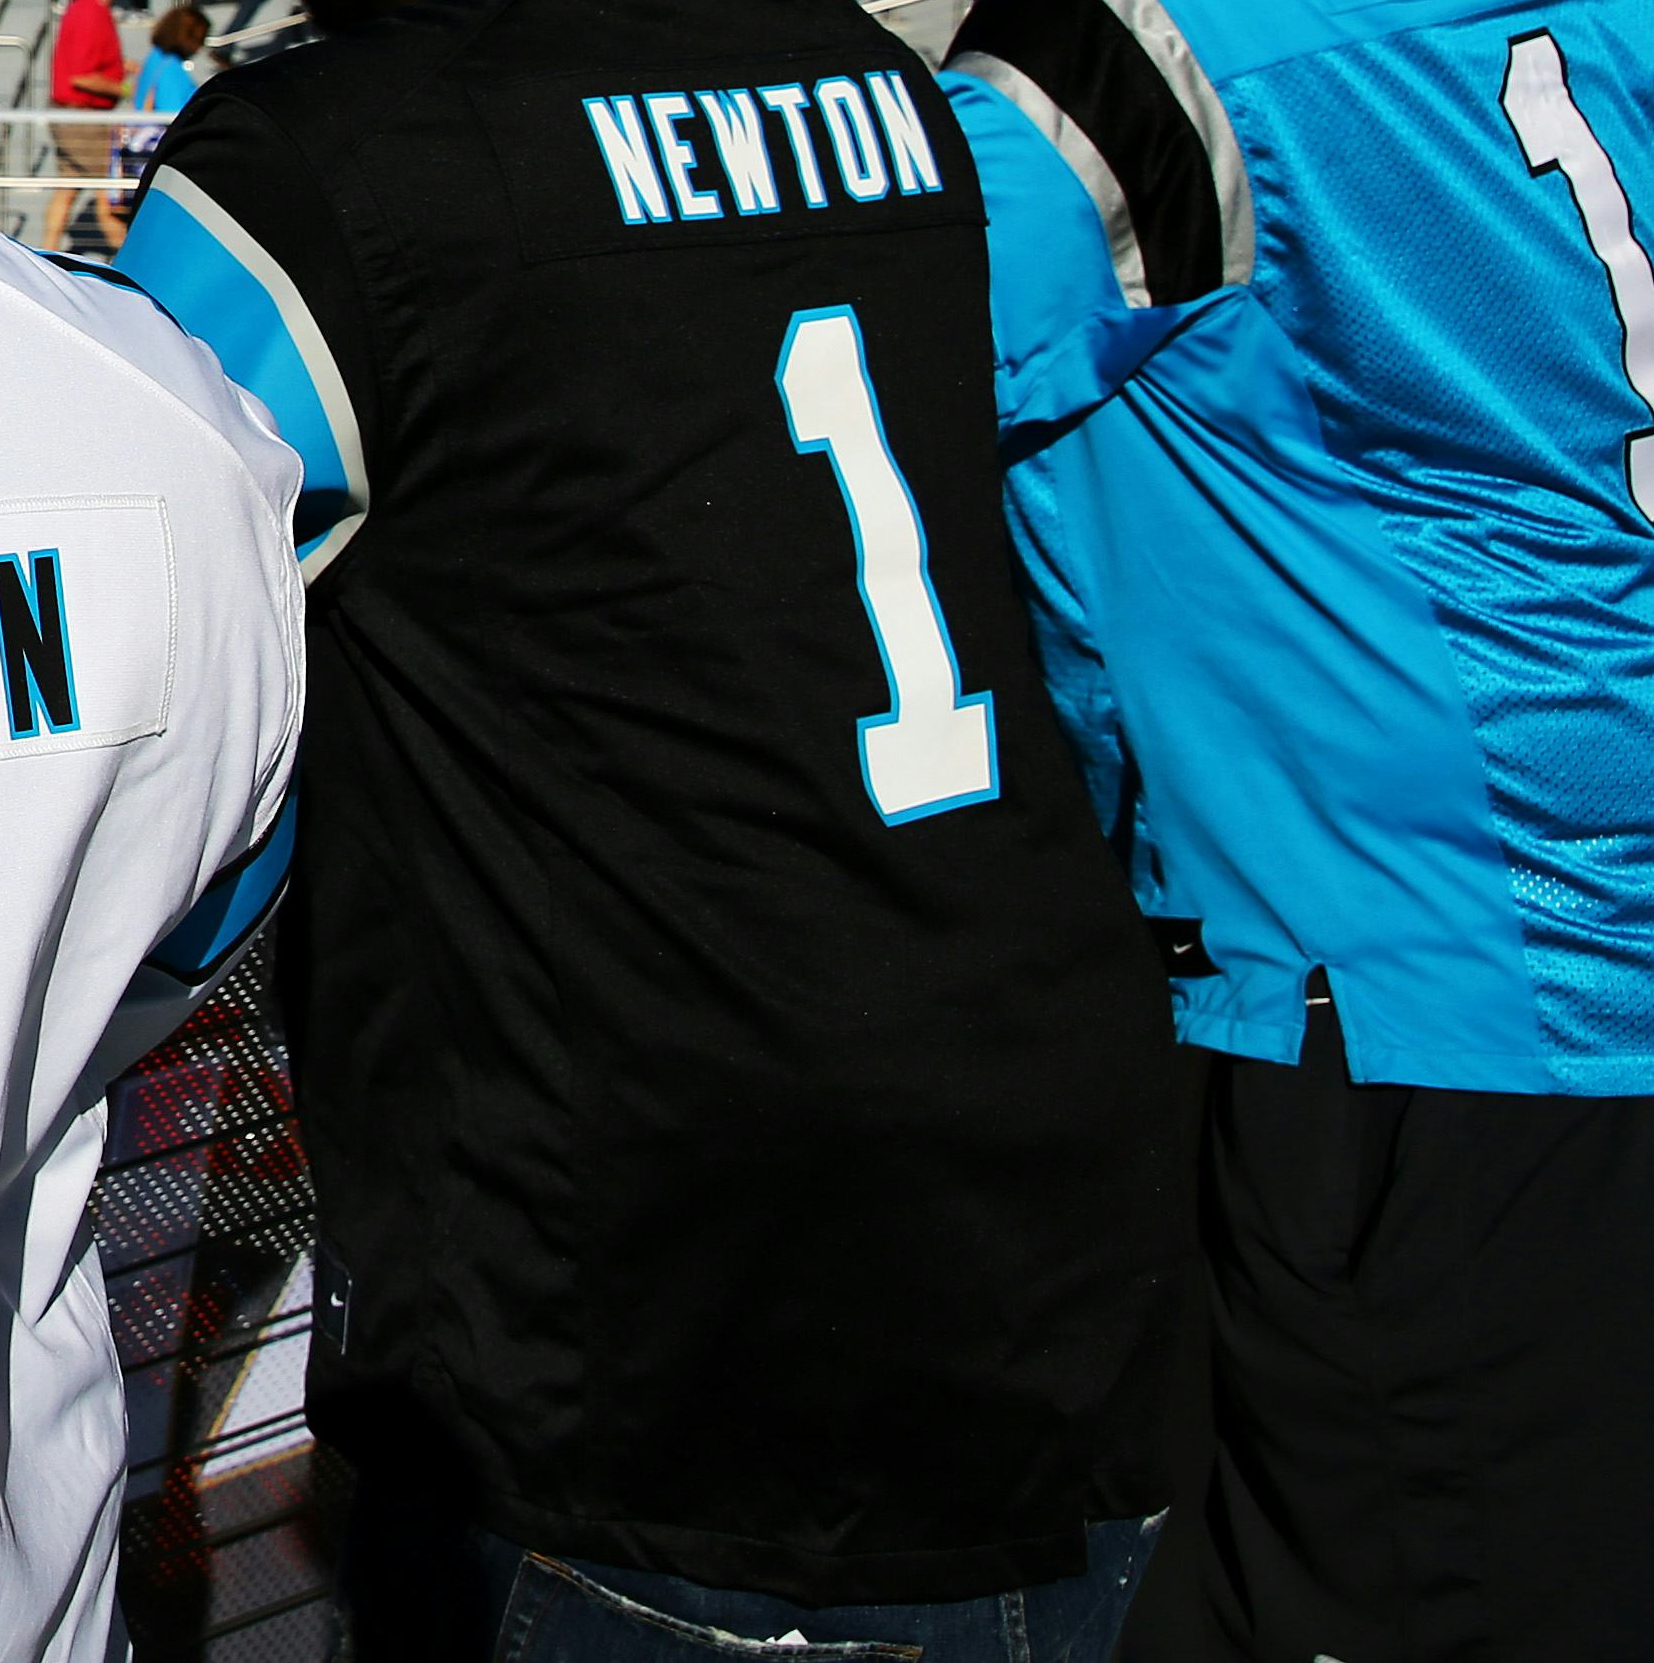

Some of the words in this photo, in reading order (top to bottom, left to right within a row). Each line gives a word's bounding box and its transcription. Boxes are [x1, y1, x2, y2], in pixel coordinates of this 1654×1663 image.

[582, 71, 943, 225] NEWTON
[1498, 26, 1654, 524] 1
[774, 304, 1000, 827] 1
